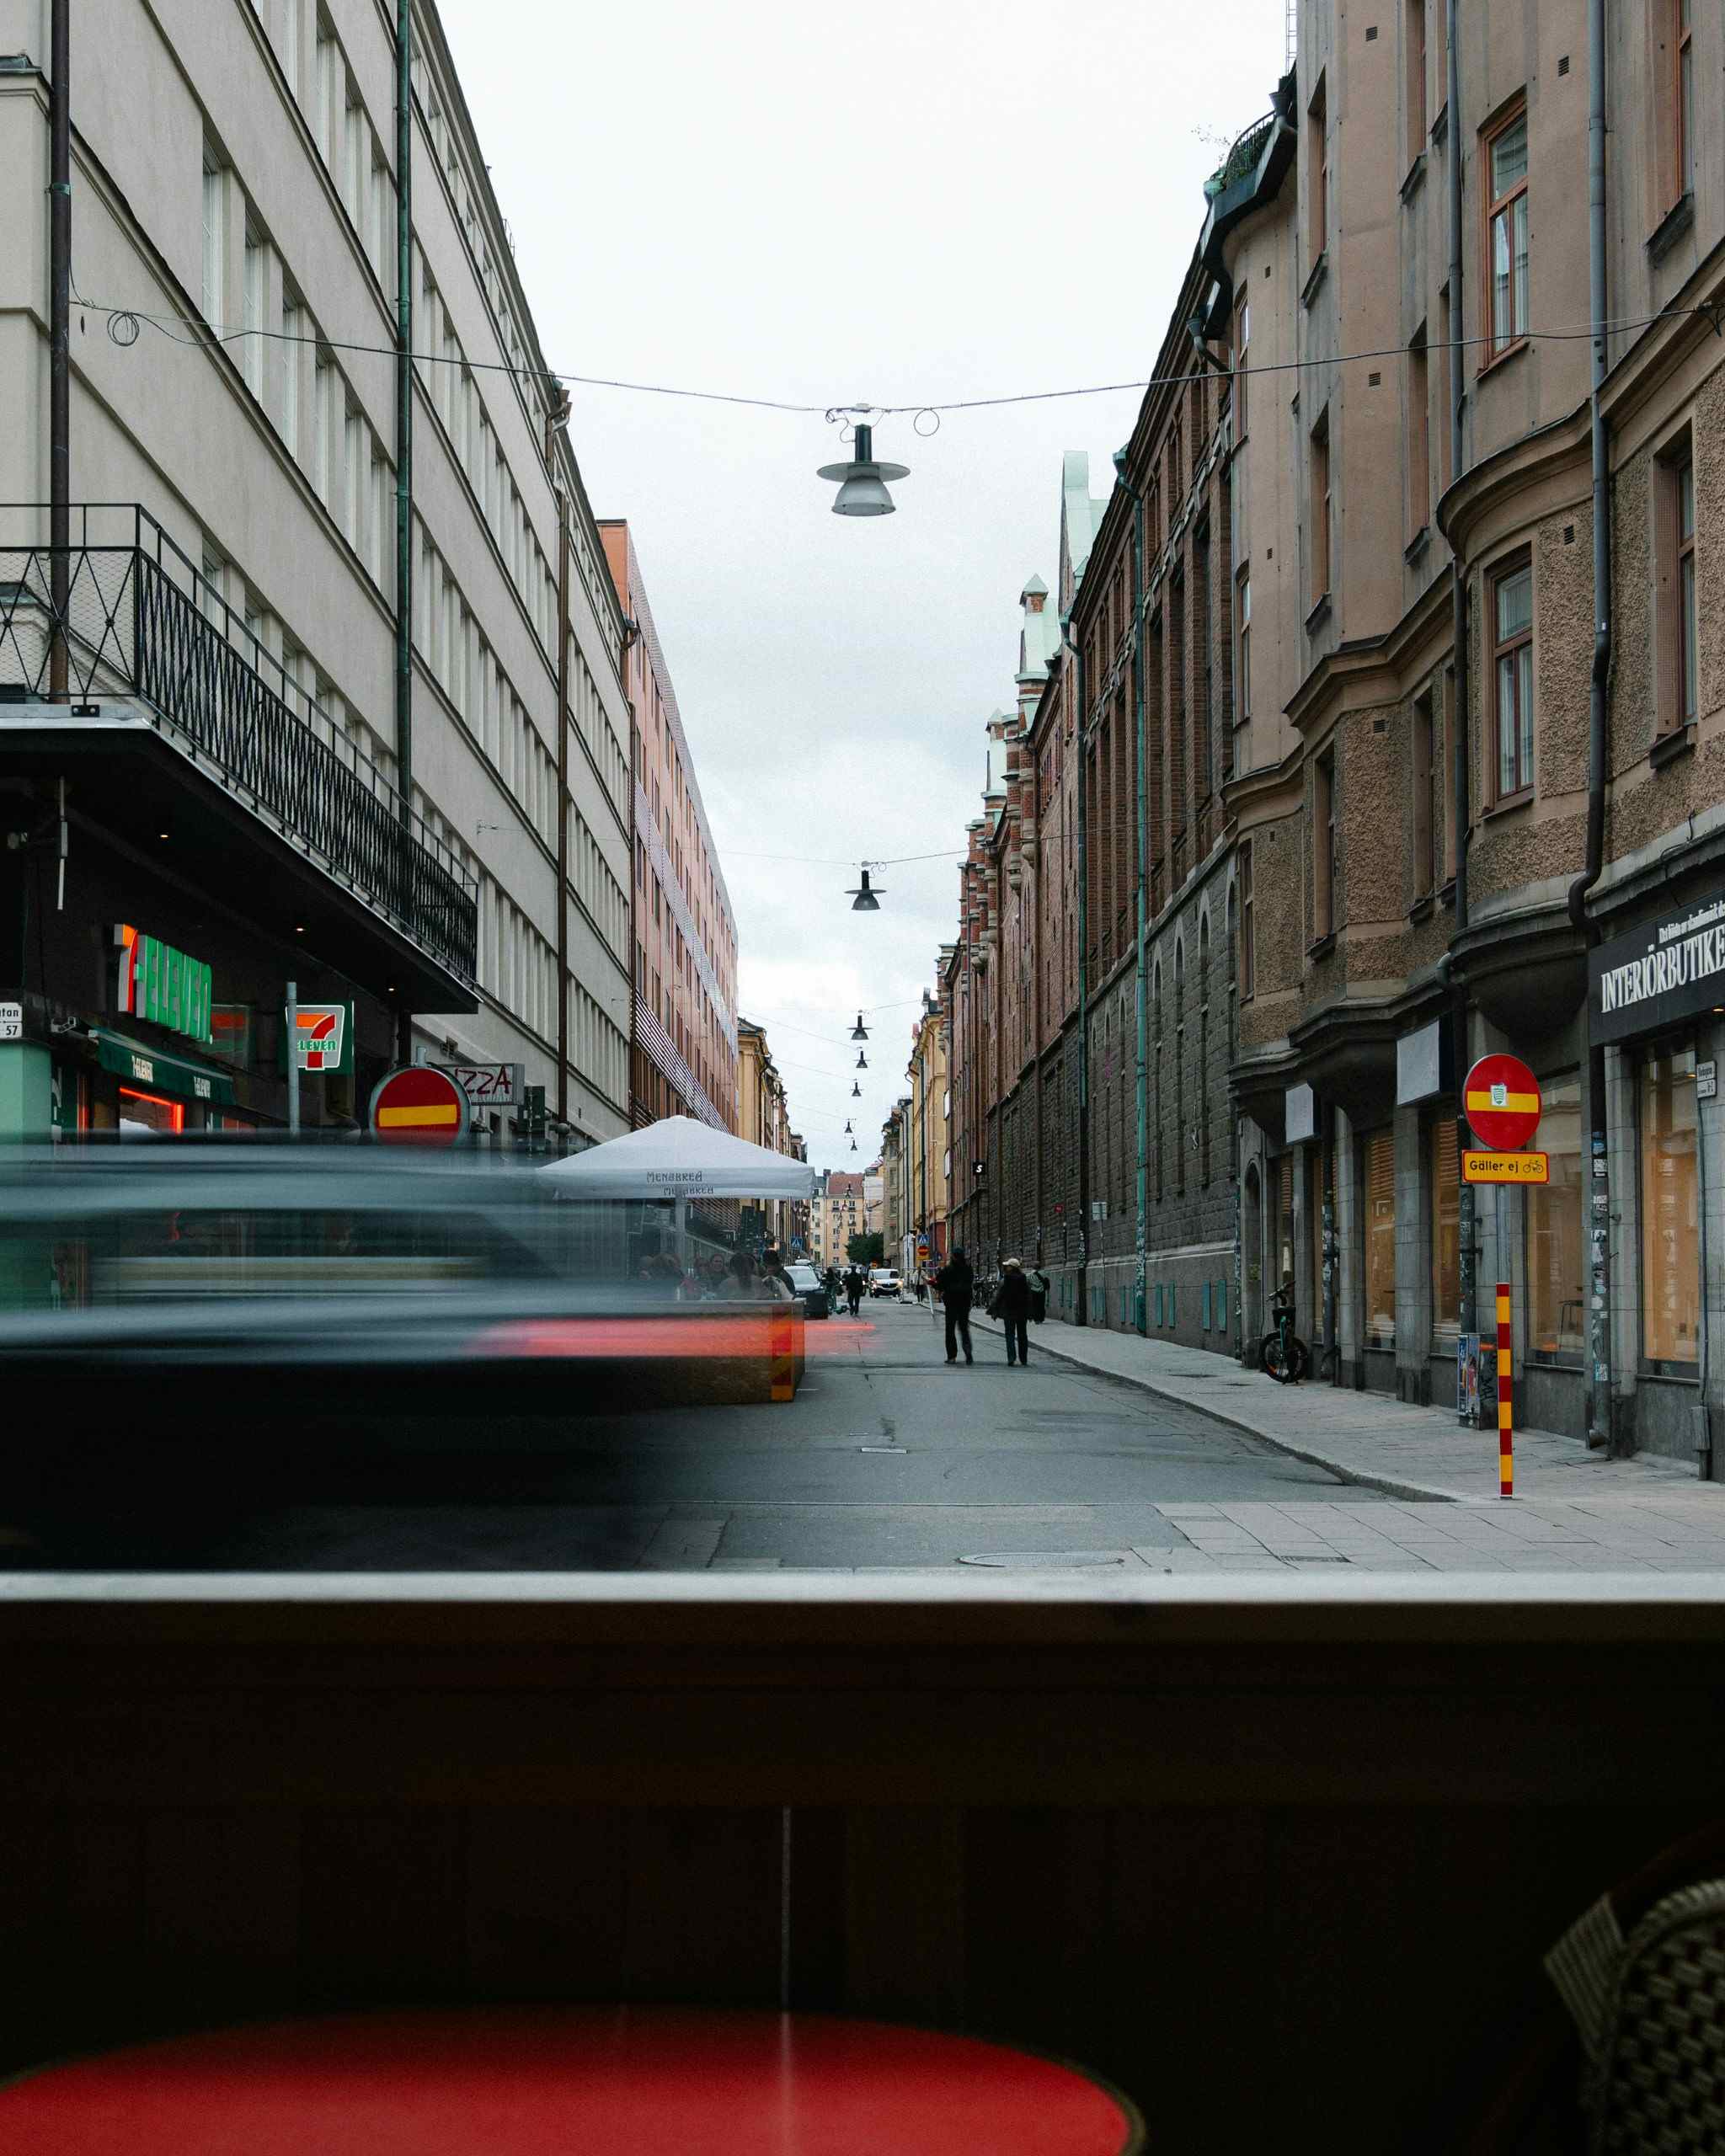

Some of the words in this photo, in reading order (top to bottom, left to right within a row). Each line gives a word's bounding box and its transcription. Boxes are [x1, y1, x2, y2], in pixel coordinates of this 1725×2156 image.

[0, 1008, 19, 1017] tan
[6, 1025, 18, 1036] 57
[455, 1065, 512, 1094] ZZA
[1470, 1160, 1503, 1171] Gäller
[1509, 1161, 1519, 1173] ej
[646, 1171, 702, 1182] MENABREA
